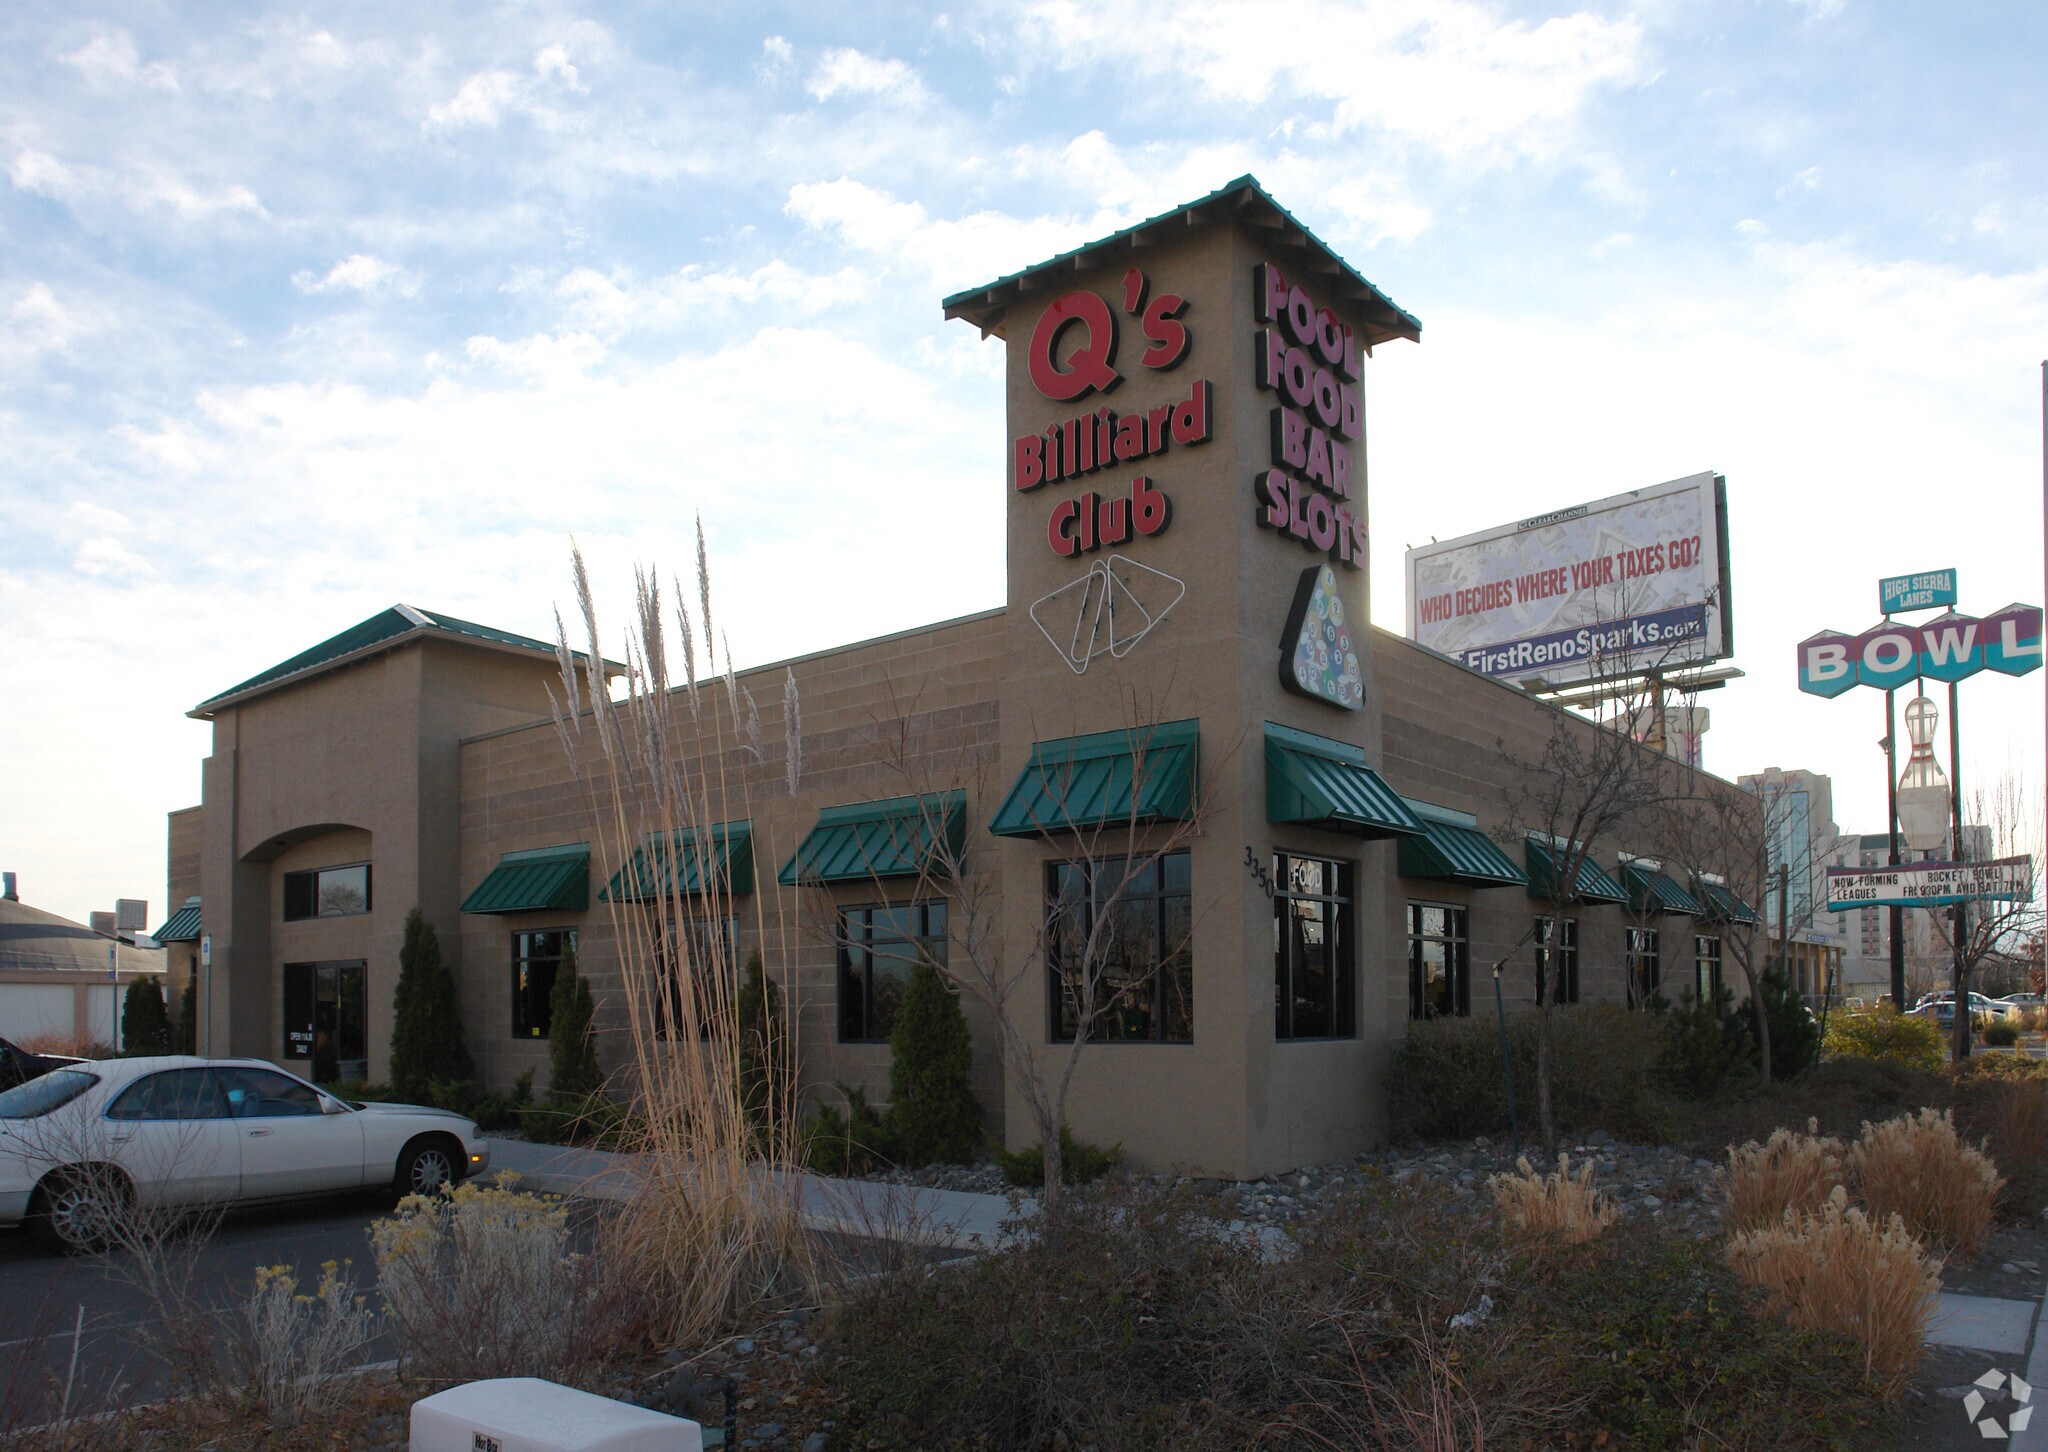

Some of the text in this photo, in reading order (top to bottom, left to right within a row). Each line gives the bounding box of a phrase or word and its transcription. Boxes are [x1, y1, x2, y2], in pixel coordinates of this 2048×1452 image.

[1028, 268, 1190, 401] Q's
[1256, 262, 1361, 382] POOL
[1257, 328, 1363, 440] FOOD
[1015, 378, 1211, 492] Billiard
[1272, 406, 1352, 500] BAR
[1048, 476, 1169, 557] Club
[1257, 468, 1369, 571] SLOTS
[1420, 592, 1453, 625] WHO
[1455, 578, 1513, 617] DECIDES
[1515, 566, 1567, 604] WHERE
[1570, 555, 1614, 592] YOUR
[1668, 535, 1701, 571] GO?
[1884, 572, 1952, 602] HIGH SIERRA
[1899, 590, 1935, 608] LANES
[1468, 619, 1702, 674] FirstRenoSparks.com
[1807, 619, 2042, 683] BOWL
[1244, 846, 1275, 898] 3350
[1291, 864, 1322, 888] FOOD
[1834, 874, 1899, 888] NOW FORMING
[1837, 887, 1877, 900] LEAGUES
[1920, 884, 1951, 896] 930PM
[1927, 869, 1964, 883] ROCKET
